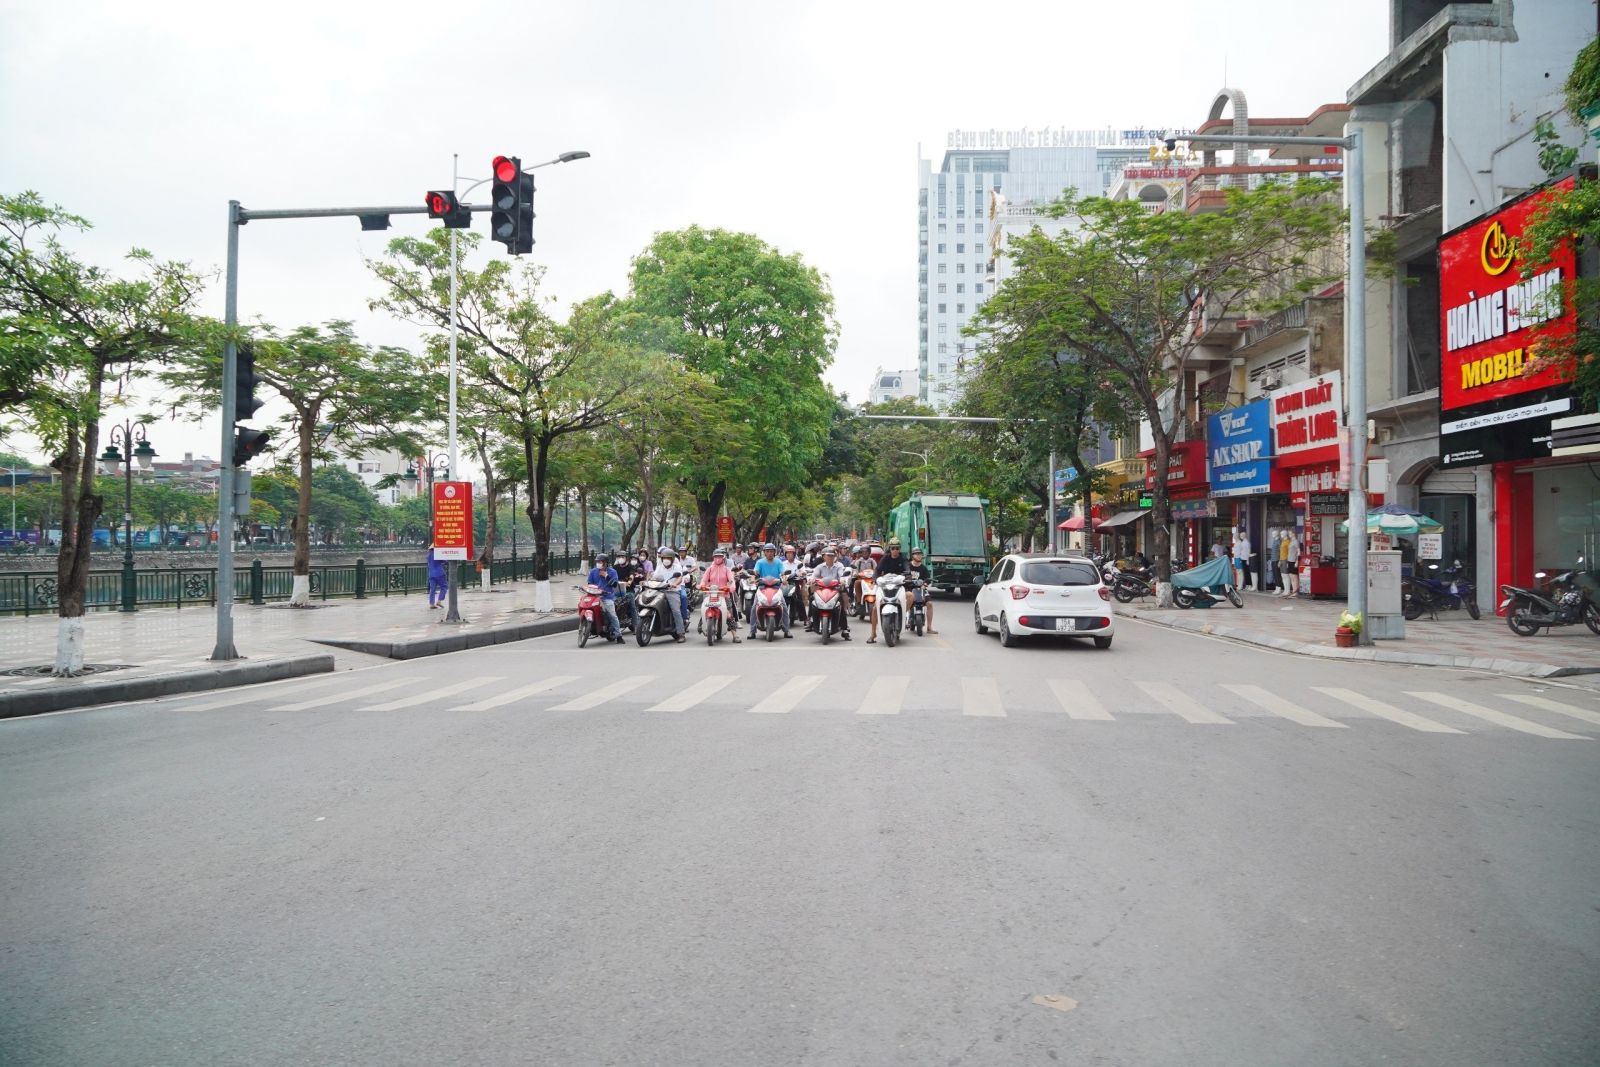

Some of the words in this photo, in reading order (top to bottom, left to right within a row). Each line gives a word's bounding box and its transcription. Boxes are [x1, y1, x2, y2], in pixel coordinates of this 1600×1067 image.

[1447, 291, 1504, 351] HOÀNG
[1304, 378, 1333, 408] MẮT
[1308, 410, 1337, 442] LONG
